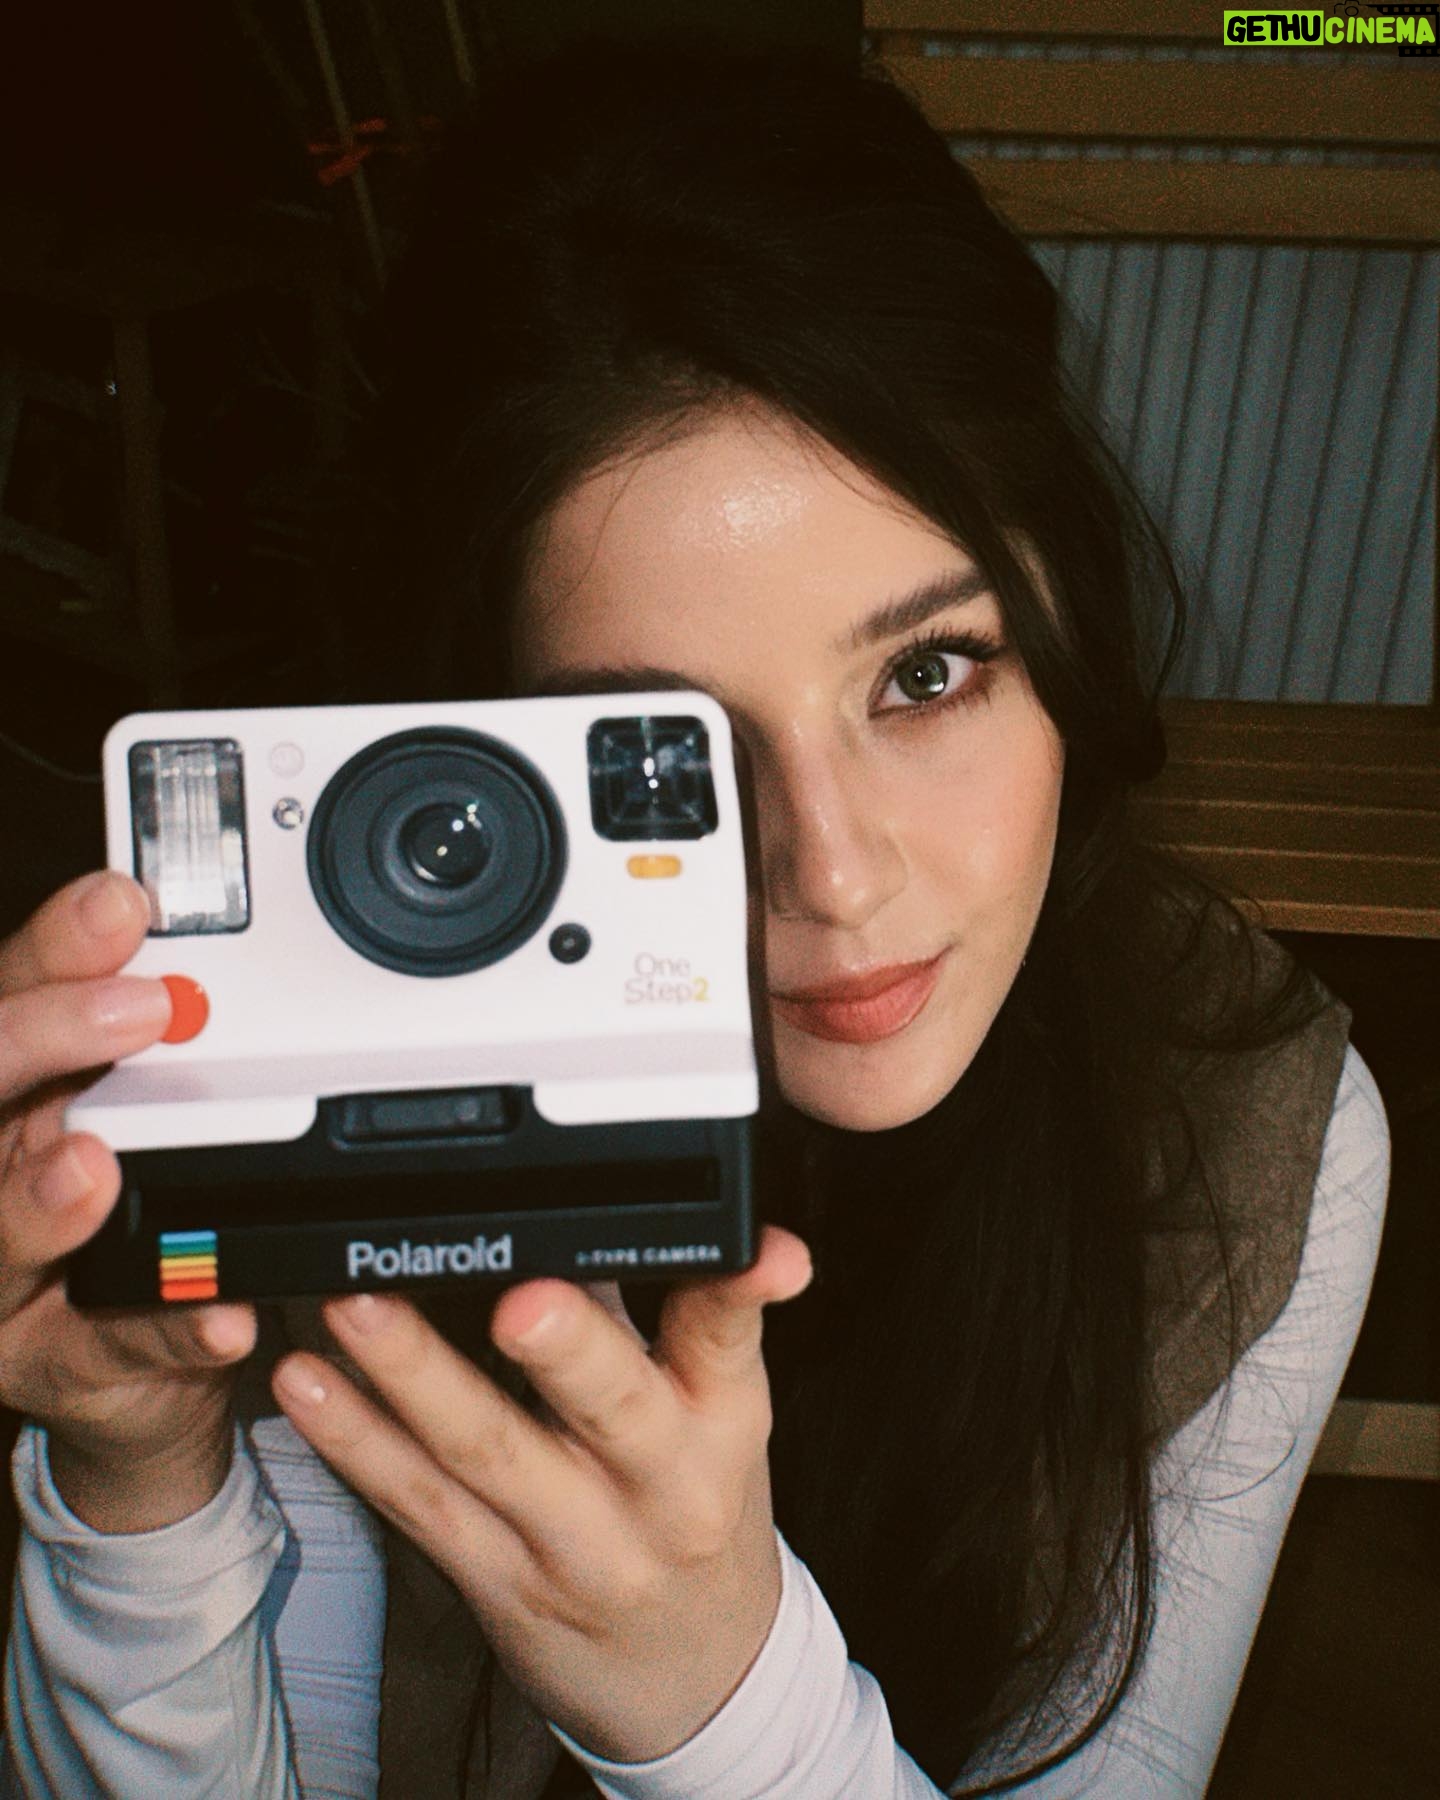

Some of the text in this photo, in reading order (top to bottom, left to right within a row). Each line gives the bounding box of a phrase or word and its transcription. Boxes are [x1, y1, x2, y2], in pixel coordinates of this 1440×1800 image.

[634, 952, 690, 976] One
[624, 977, 711, 1006] Step2
[347, 1234, 512, 1277] Polaroid
[642, 1245, 721, 1263] CAMERA
